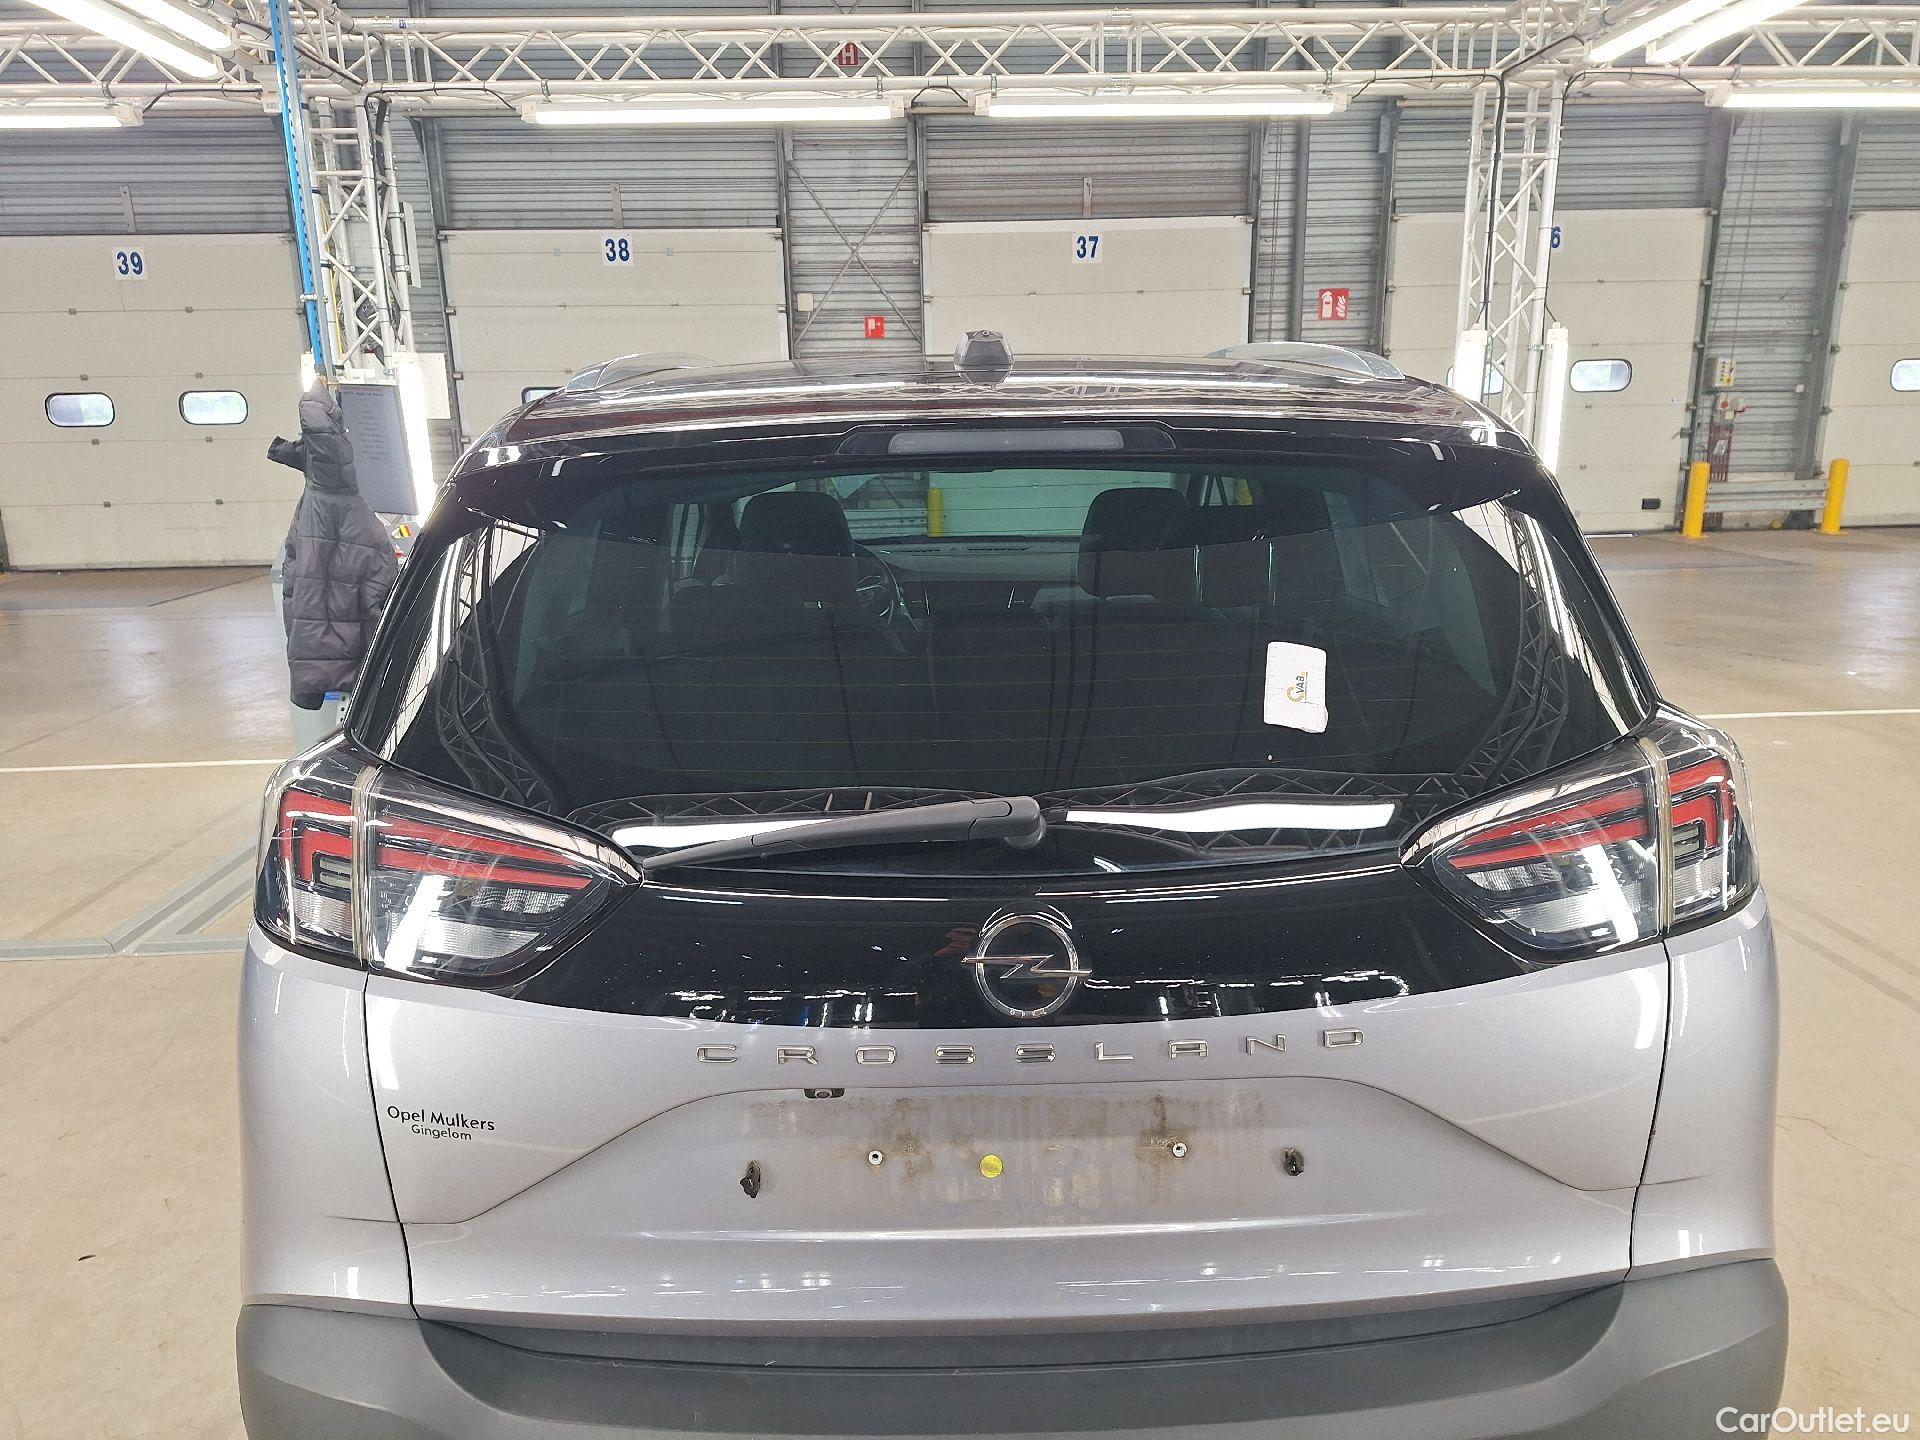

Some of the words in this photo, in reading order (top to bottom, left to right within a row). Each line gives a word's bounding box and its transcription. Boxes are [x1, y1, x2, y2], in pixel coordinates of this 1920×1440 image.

[605, 238, 630, 262] 38
[1076, 235, 1099, 259] 37
[116, 250, 143, 275] 39
[1295, 675, 1305, 694] VAB
[696, 1027, 1364, 1065] CROSSLAND
[387, 1105, 425, 1123] Opel
[430, 1111, 495, 1131] Mulkers
[411, 1123, 472, 1141] Gingelom
